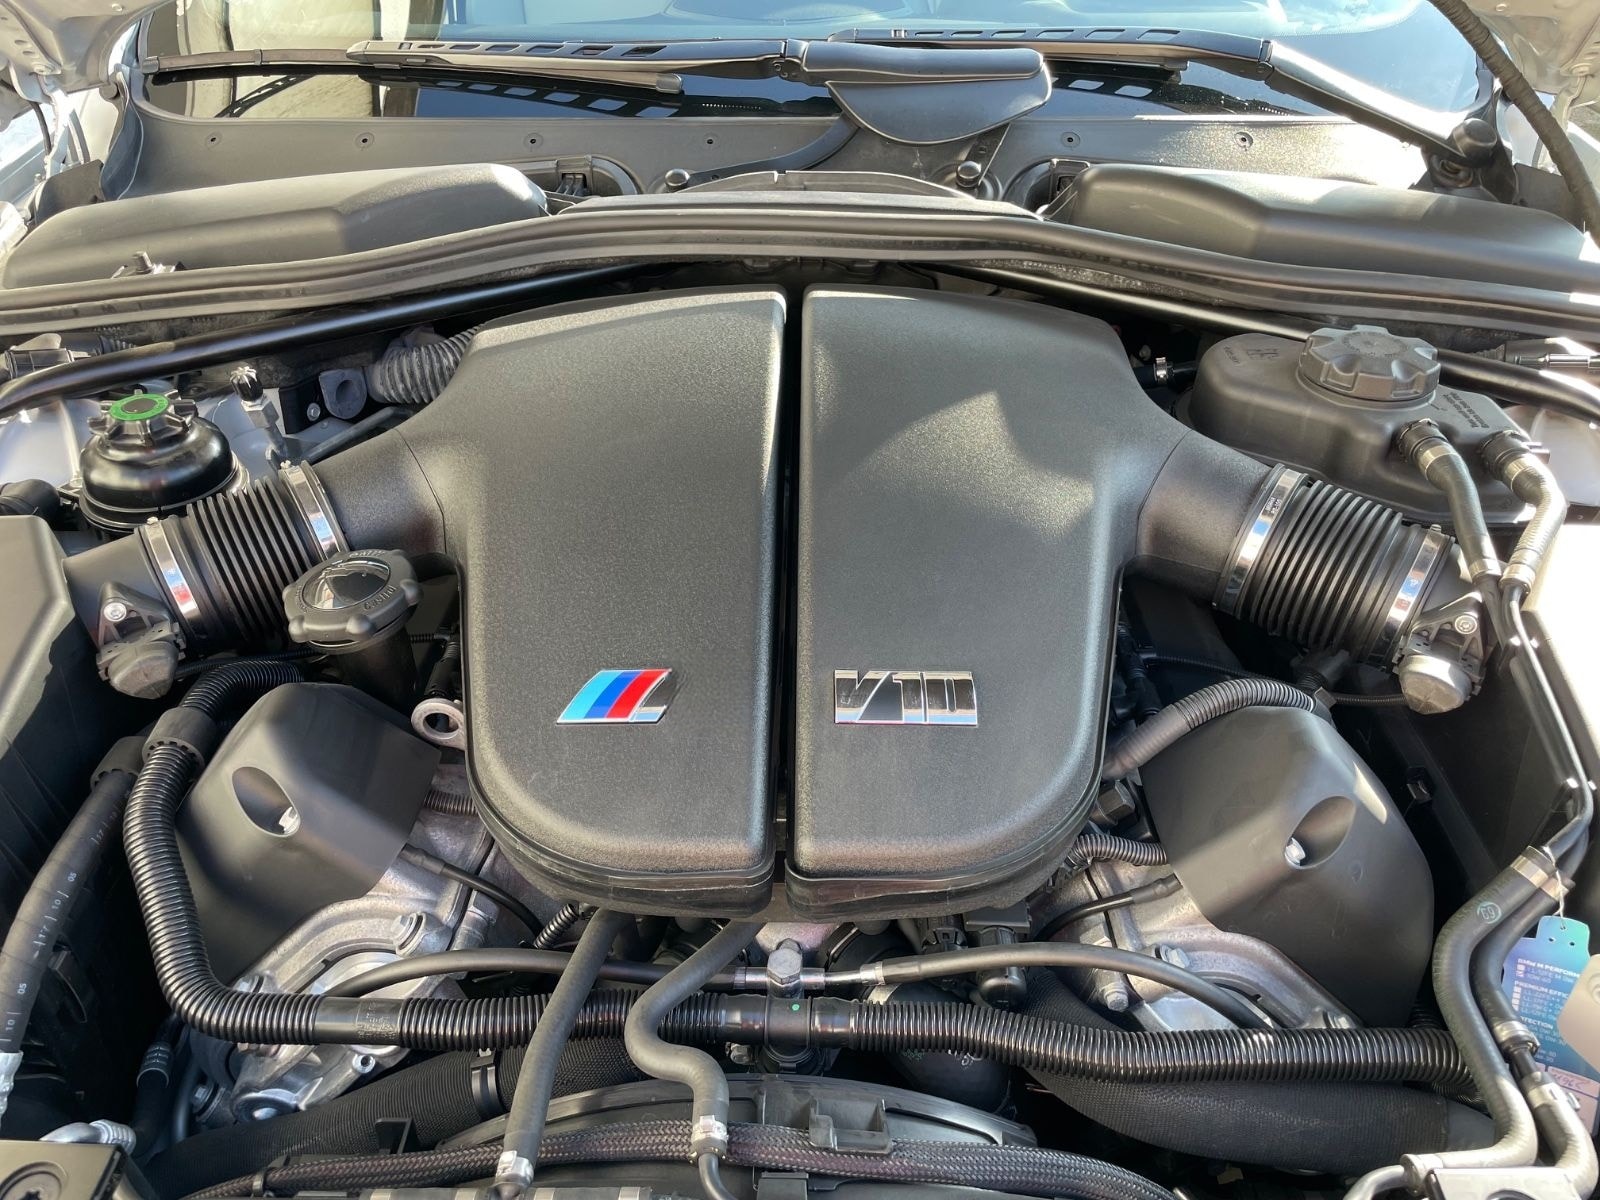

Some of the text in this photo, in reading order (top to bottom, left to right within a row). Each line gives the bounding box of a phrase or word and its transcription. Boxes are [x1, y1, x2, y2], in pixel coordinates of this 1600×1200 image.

[834, 669, 977, 725] V10
[1517, 958, 1537, 968] BMW
[1514, 980, 1548, 993] PREMIUM
